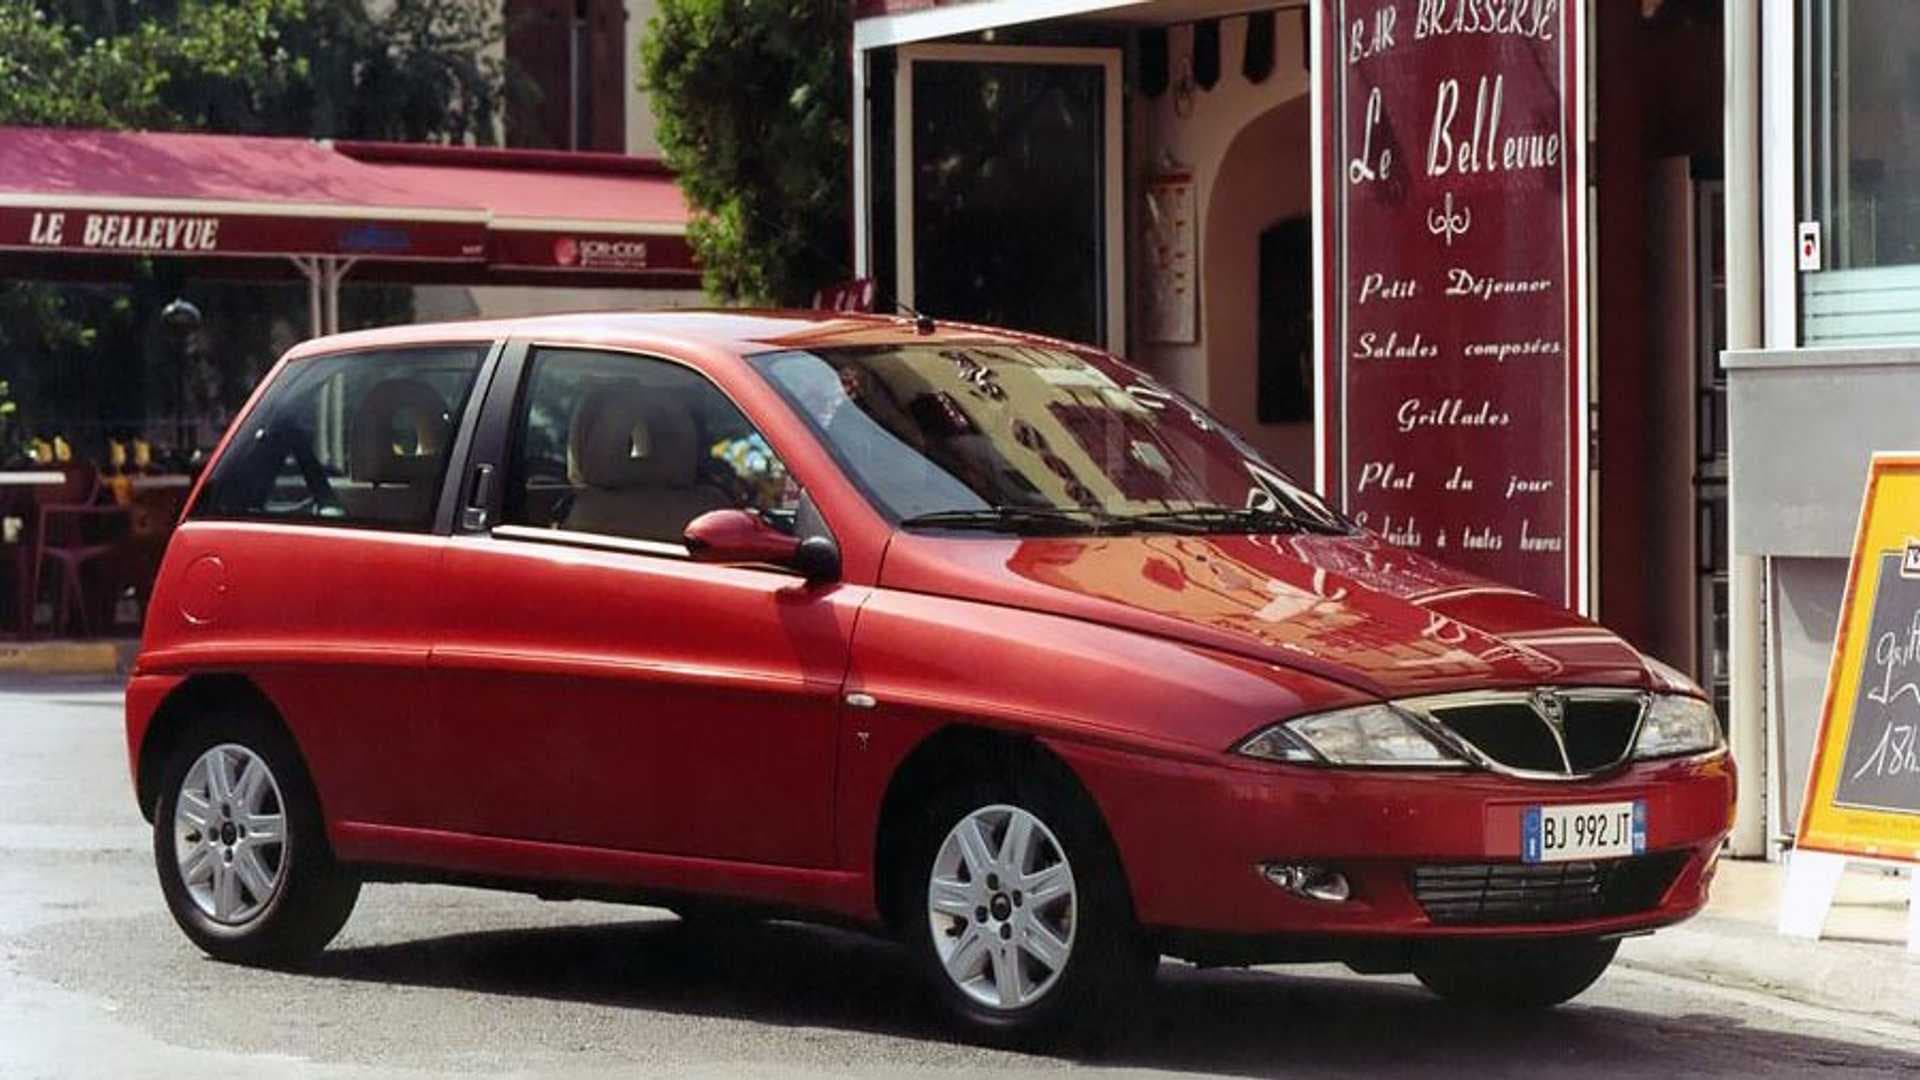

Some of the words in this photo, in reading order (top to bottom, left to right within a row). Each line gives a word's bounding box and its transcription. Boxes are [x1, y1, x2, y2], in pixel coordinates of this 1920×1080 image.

[1350, 6, 1396, 63] BAR
[1350, 87, 1392, 184] Le
[1427, 75, 1559, 176] Bellevue
[30, 212, 65, 245] LE
[83, 214, 219, 249] BELLEVUE
[1360, 273, 1416, 304] Petit
[1446, 269, 1551, 300] Déjeuner
[1353, 333, 1438, 359] Salades
[1464, 339, 1561, 362] composées
[1397, 399, 1509, 432] Grillades
[1358, 461, 1414, 493] Plat
[1445, 466, 1473, 491] du
[1505, 475, 1552, 499] jour
[1543, 817, 1568, 850] BJ
[1575, 813, 1608, 848] 992
[1613, 812, 1631, 845] JT
